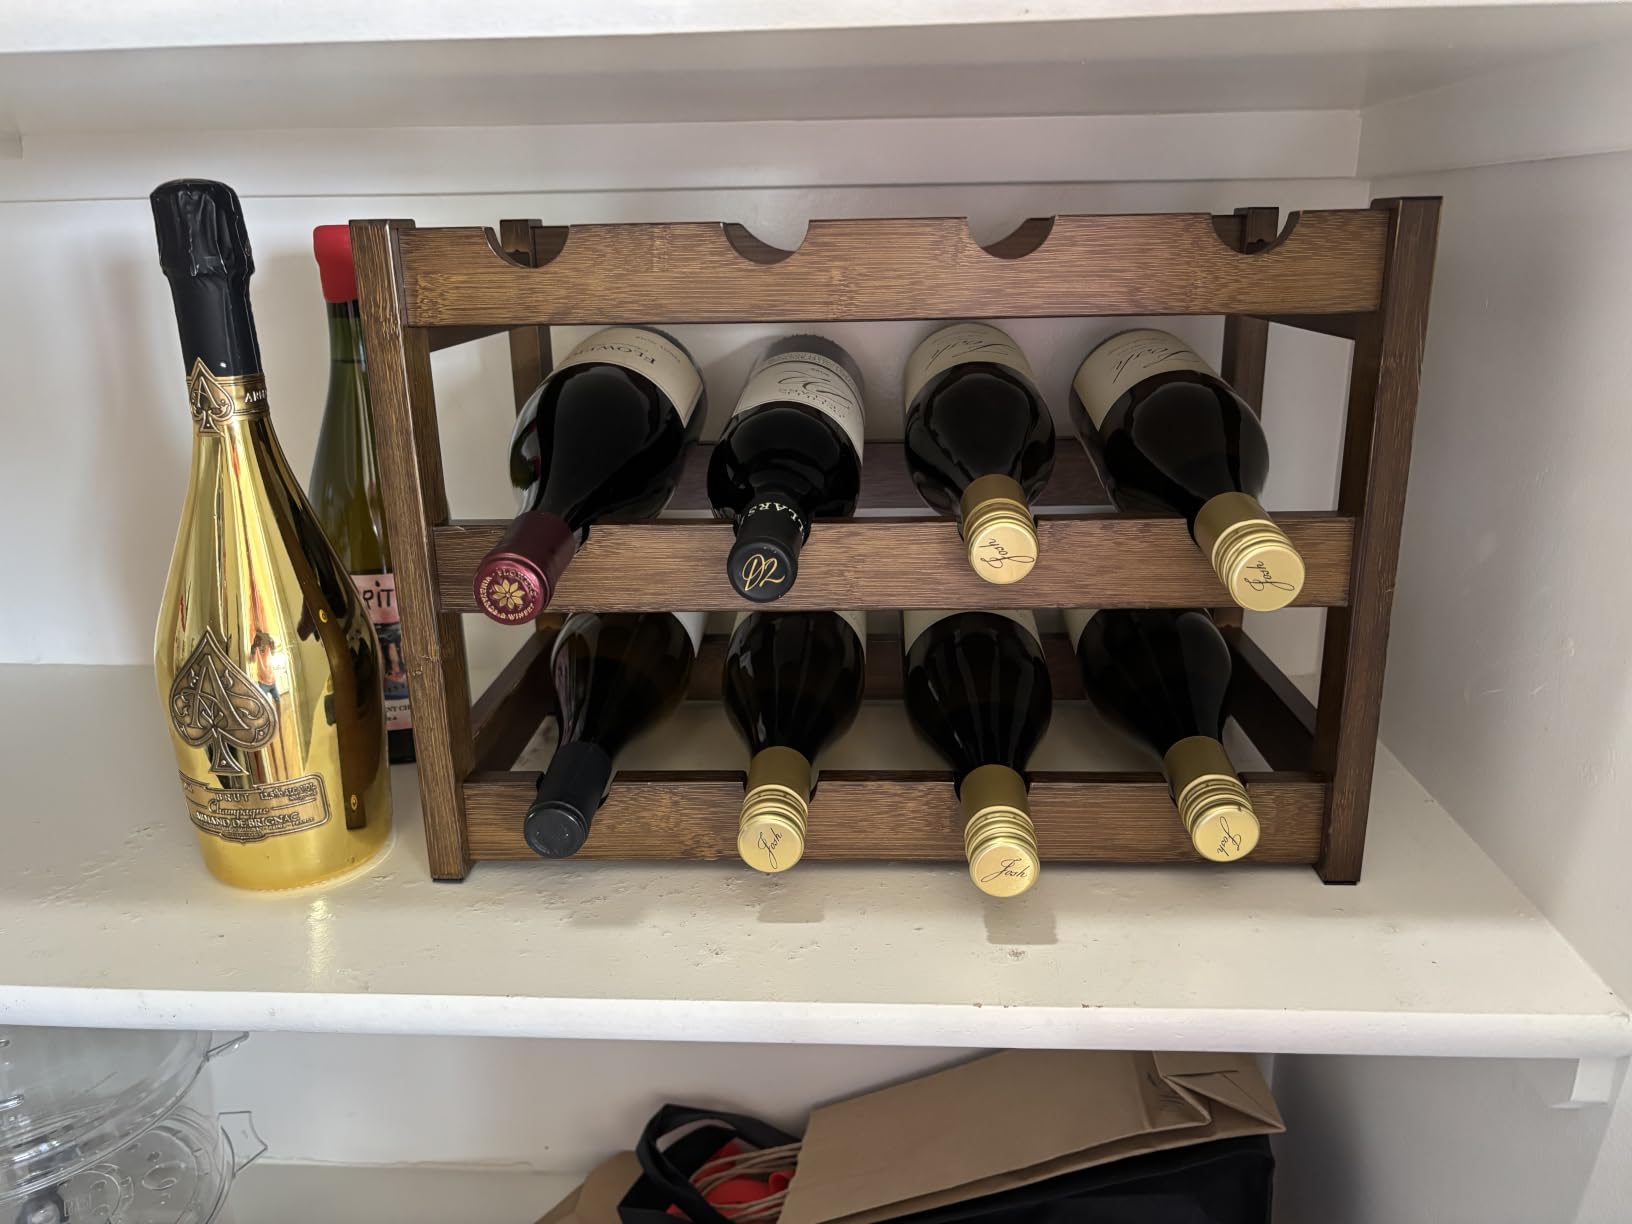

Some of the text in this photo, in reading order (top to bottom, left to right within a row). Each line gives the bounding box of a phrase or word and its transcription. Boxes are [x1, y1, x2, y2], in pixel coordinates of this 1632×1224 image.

[978, 538, 1035, 569] Josh
[1243, 560, 1296, 592] Josh
[216, 792, 250, 802] BRUT
[247, 811, 300, 828] BRIGNAC
[757, 826, 783, 870] Josh
[1215, 815, 1242, 857] Josh
[980, 858, 1031, 883] Josh
